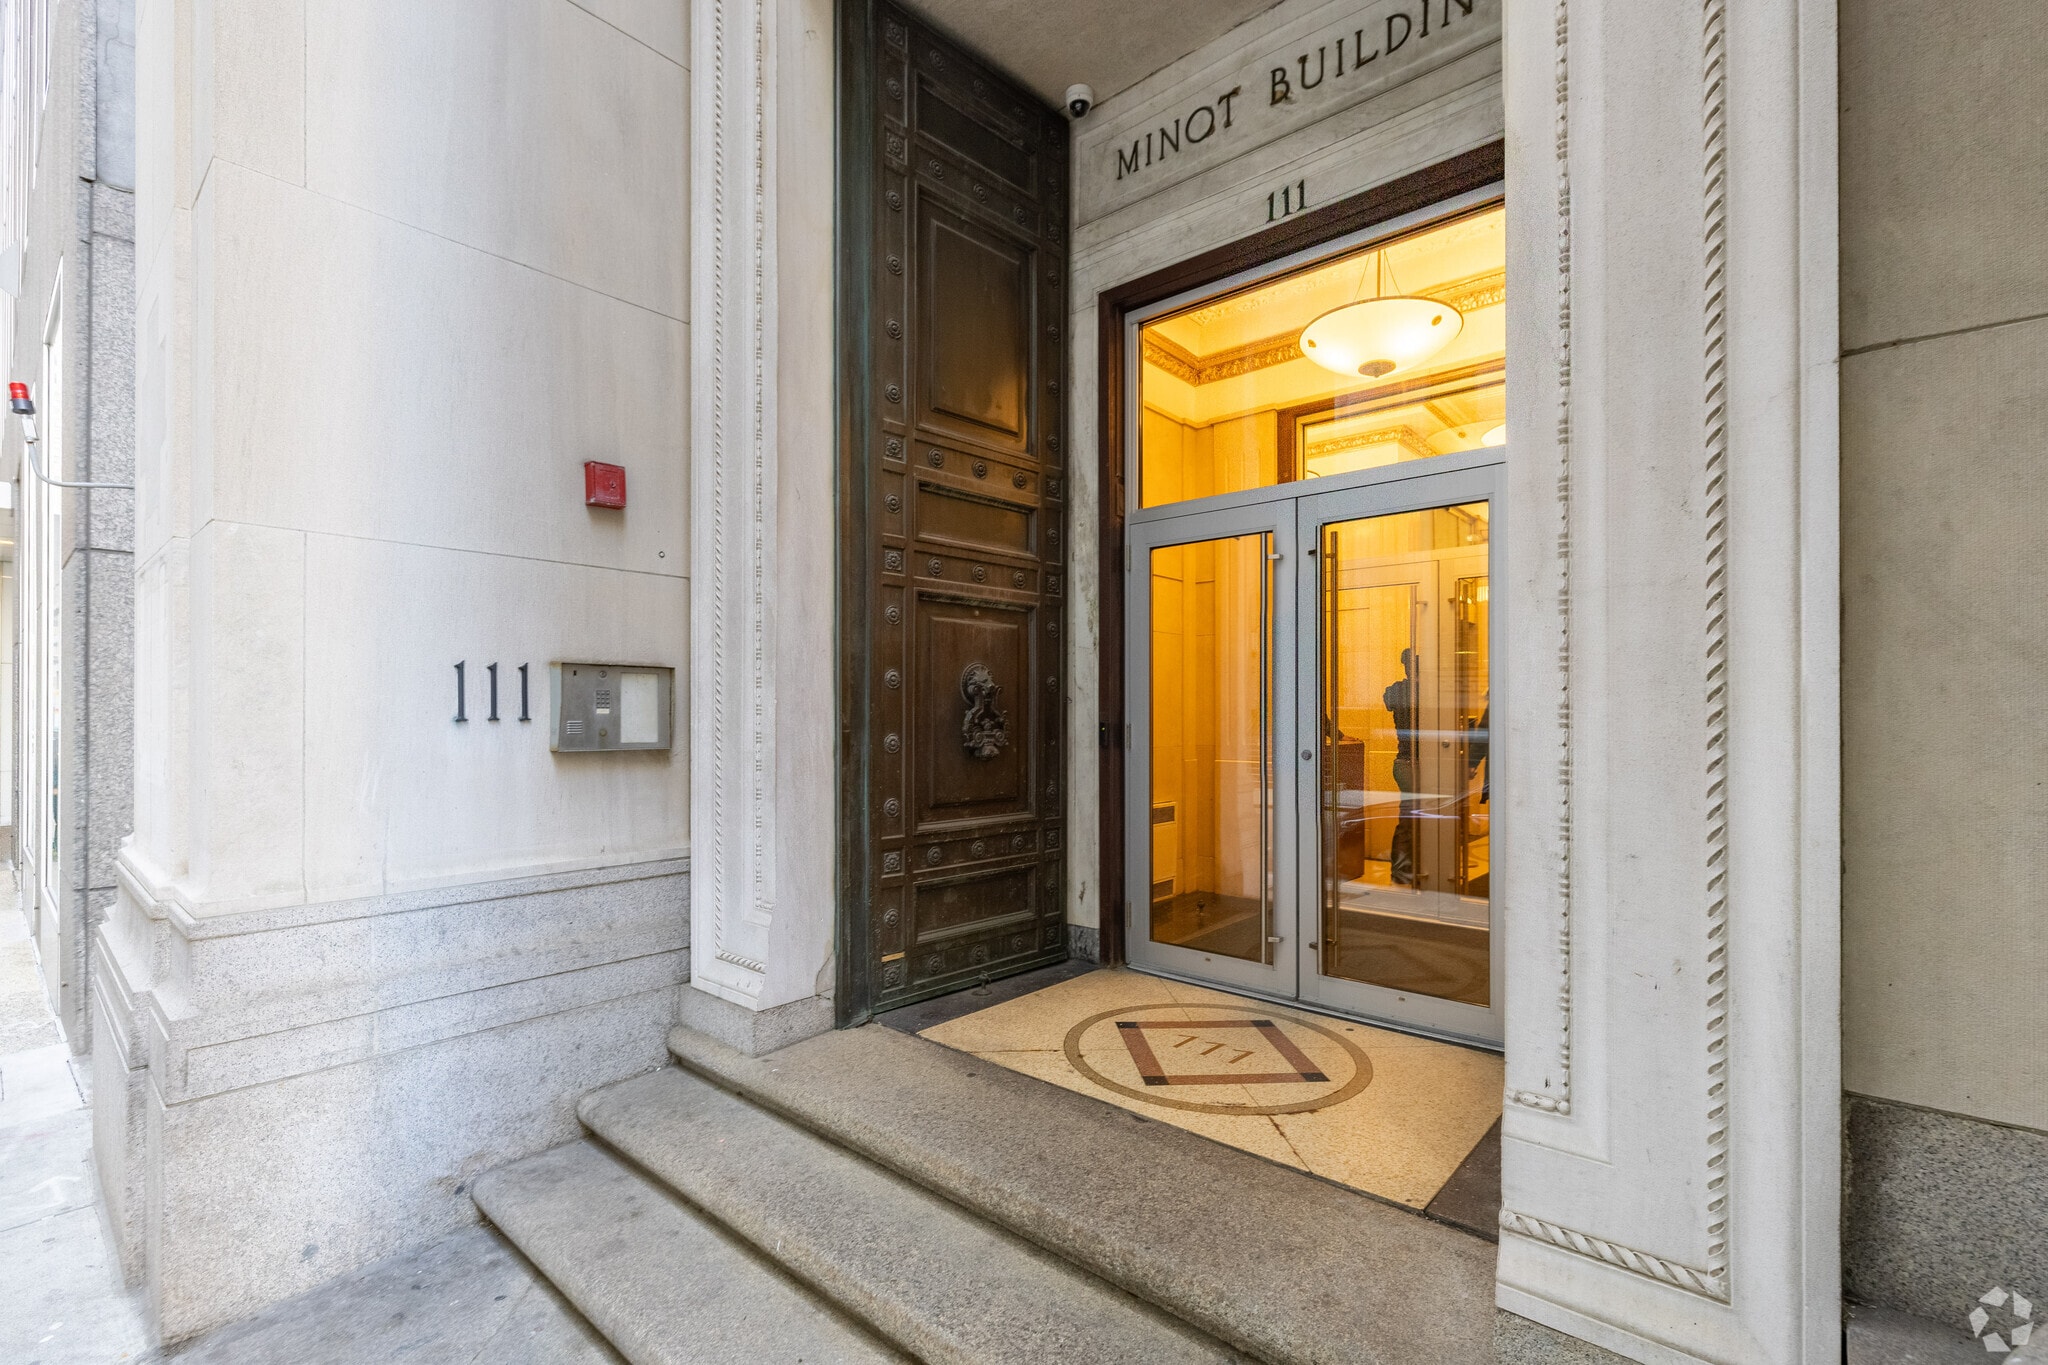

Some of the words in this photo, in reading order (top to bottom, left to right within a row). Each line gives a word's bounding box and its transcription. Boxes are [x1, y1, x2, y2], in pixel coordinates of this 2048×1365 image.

[1116, 86, 1241, 180] MINOT
[1266, 179, 1308, 224] 111
[455, 660, 532, 722] 111
